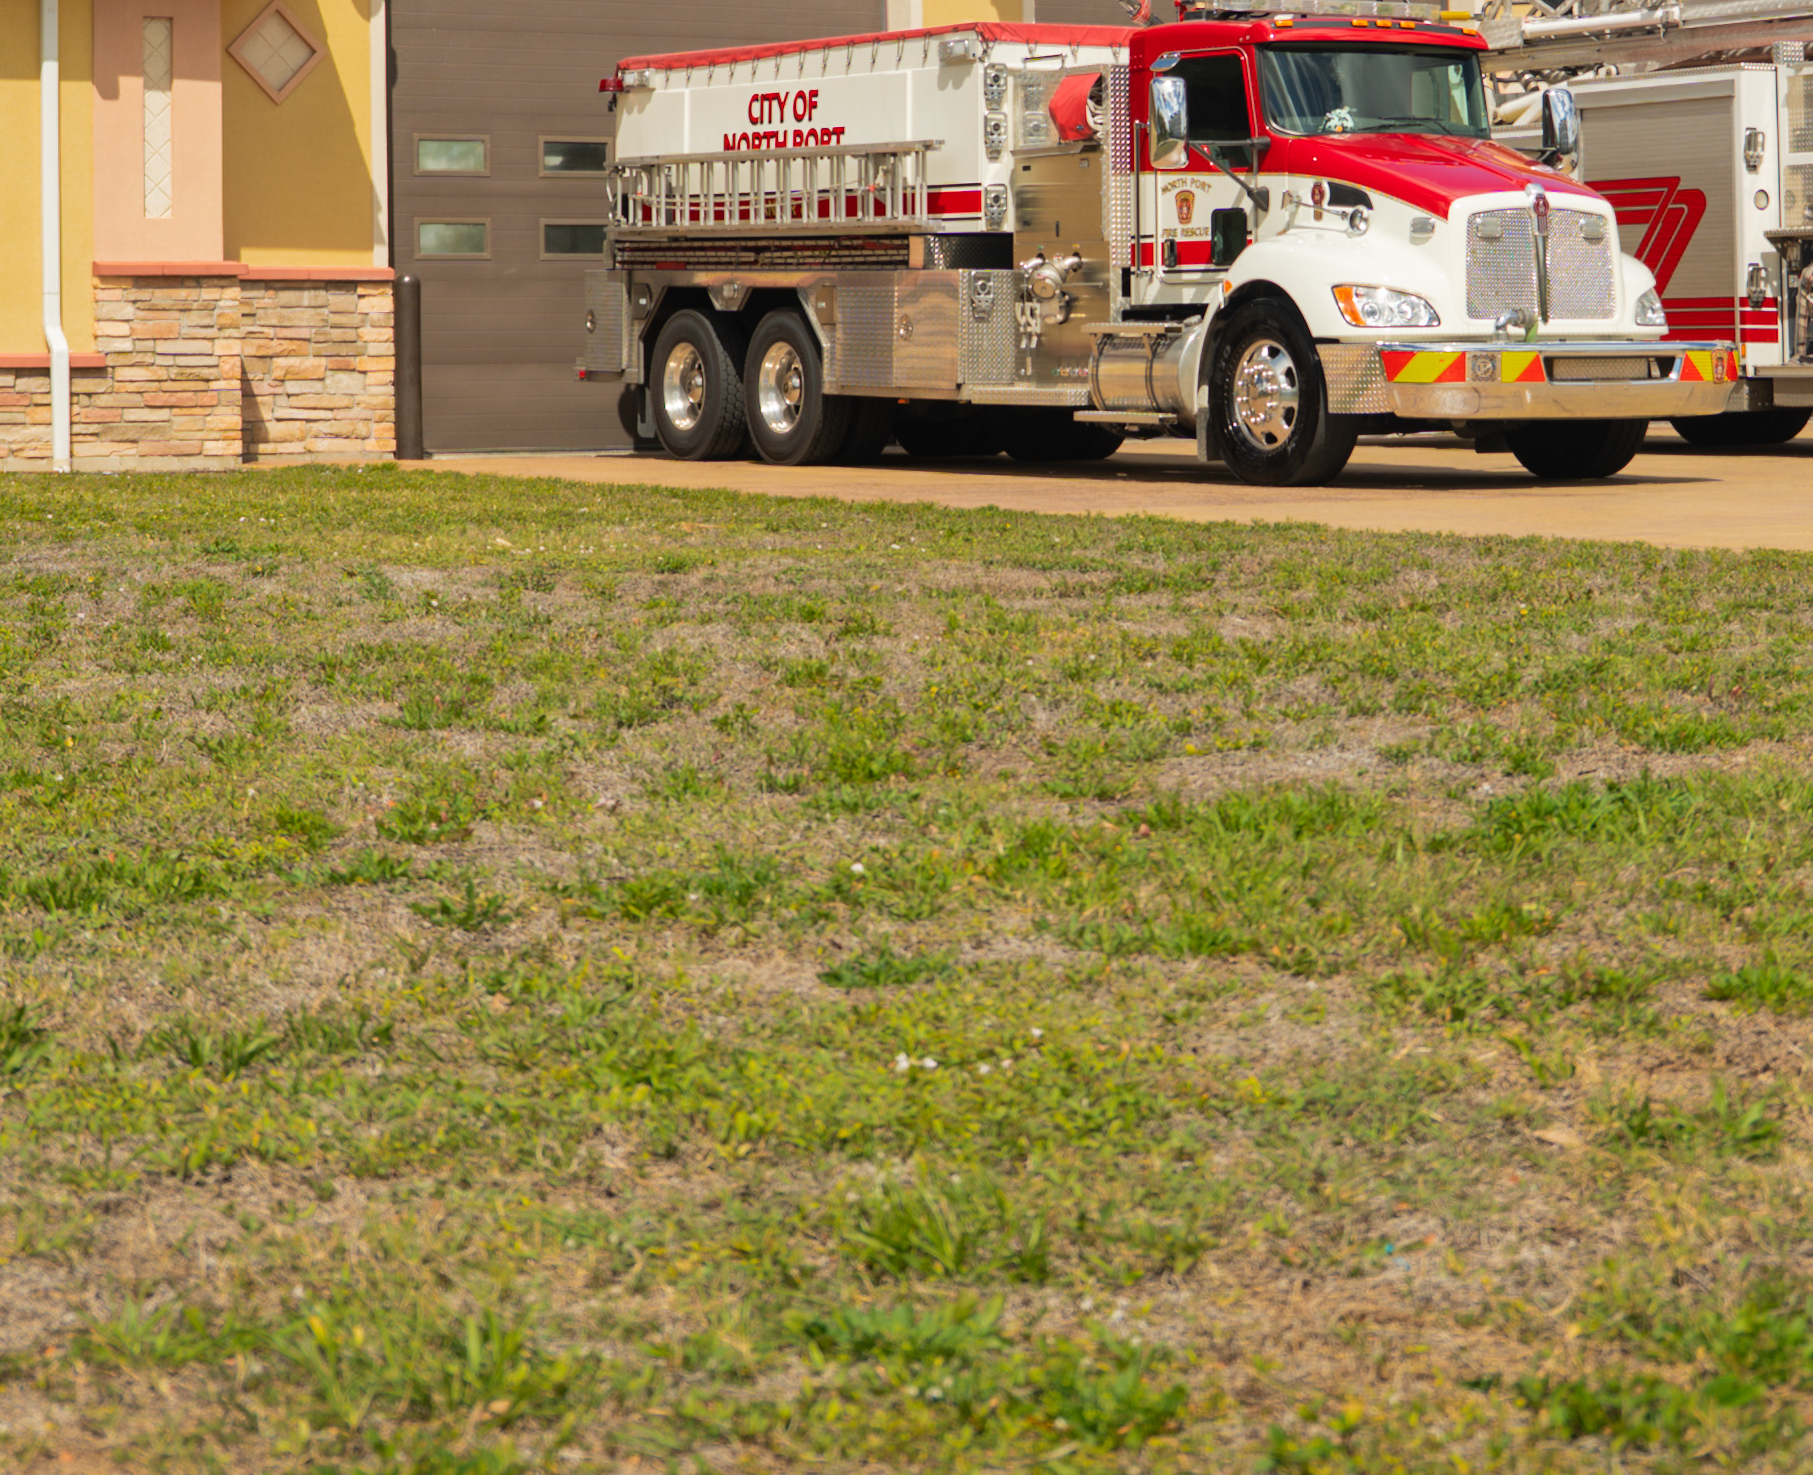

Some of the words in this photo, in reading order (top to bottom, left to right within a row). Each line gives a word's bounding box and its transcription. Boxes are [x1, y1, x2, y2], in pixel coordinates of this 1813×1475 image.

[748, 91, 790, 125] CITY
[793, 89, 819, 122] OF
[723, 129, 789, 157] NORTH
[792, 126, 846, 153] PORT
[1161, 177, 1188, 196] NORTH
[1190, 177, 1212, 194] PORT
[1180, 226, 1210, 238] RESCUE
